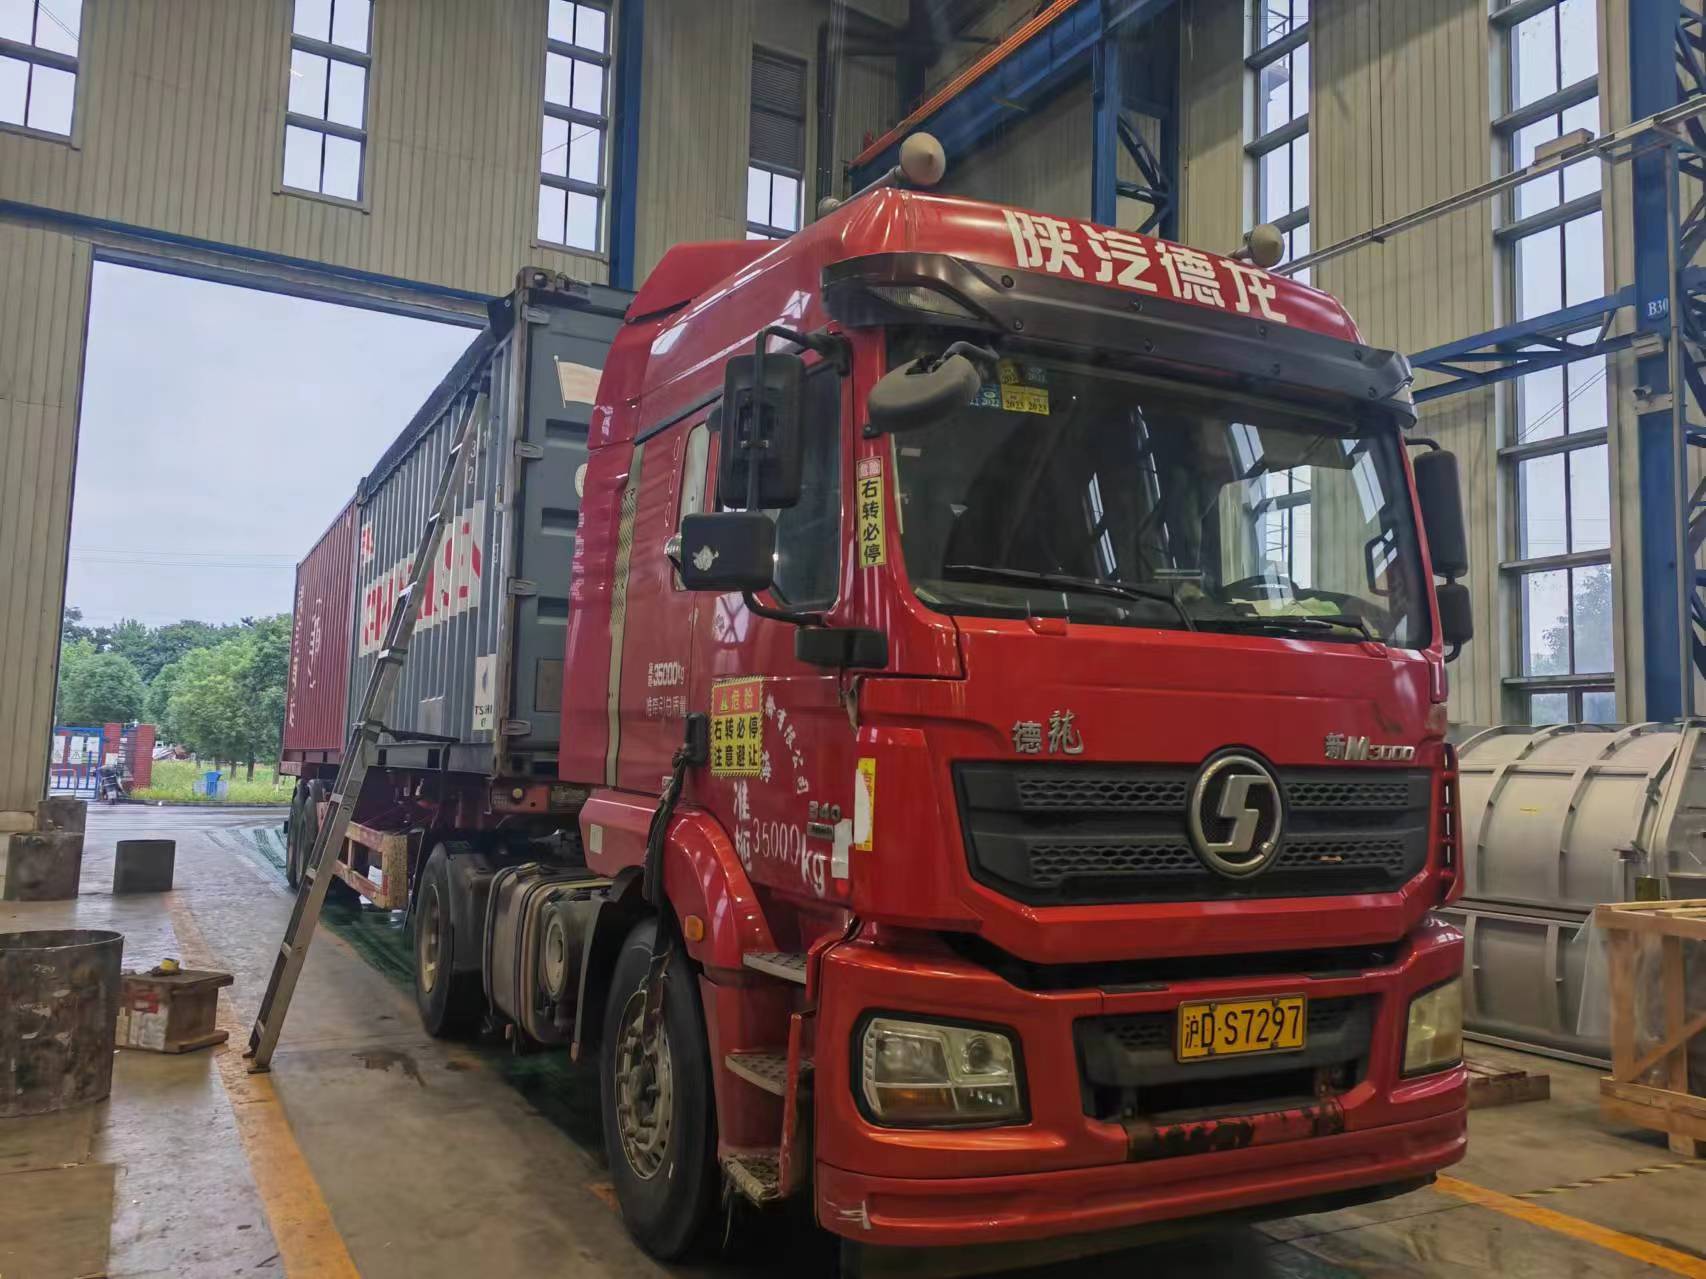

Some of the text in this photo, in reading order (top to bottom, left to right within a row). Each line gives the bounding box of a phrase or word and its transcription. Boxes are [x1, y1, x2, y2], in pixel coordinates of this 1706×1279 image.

[1002, 208, 1287, 323] 陕汽德龙
[862, 480, 881, 562] 右转必停
[731, 688, 753, 710] 危险
[714, 717, 758, 740] 右转必停
[714, 744, 758, 767] 注意避让
